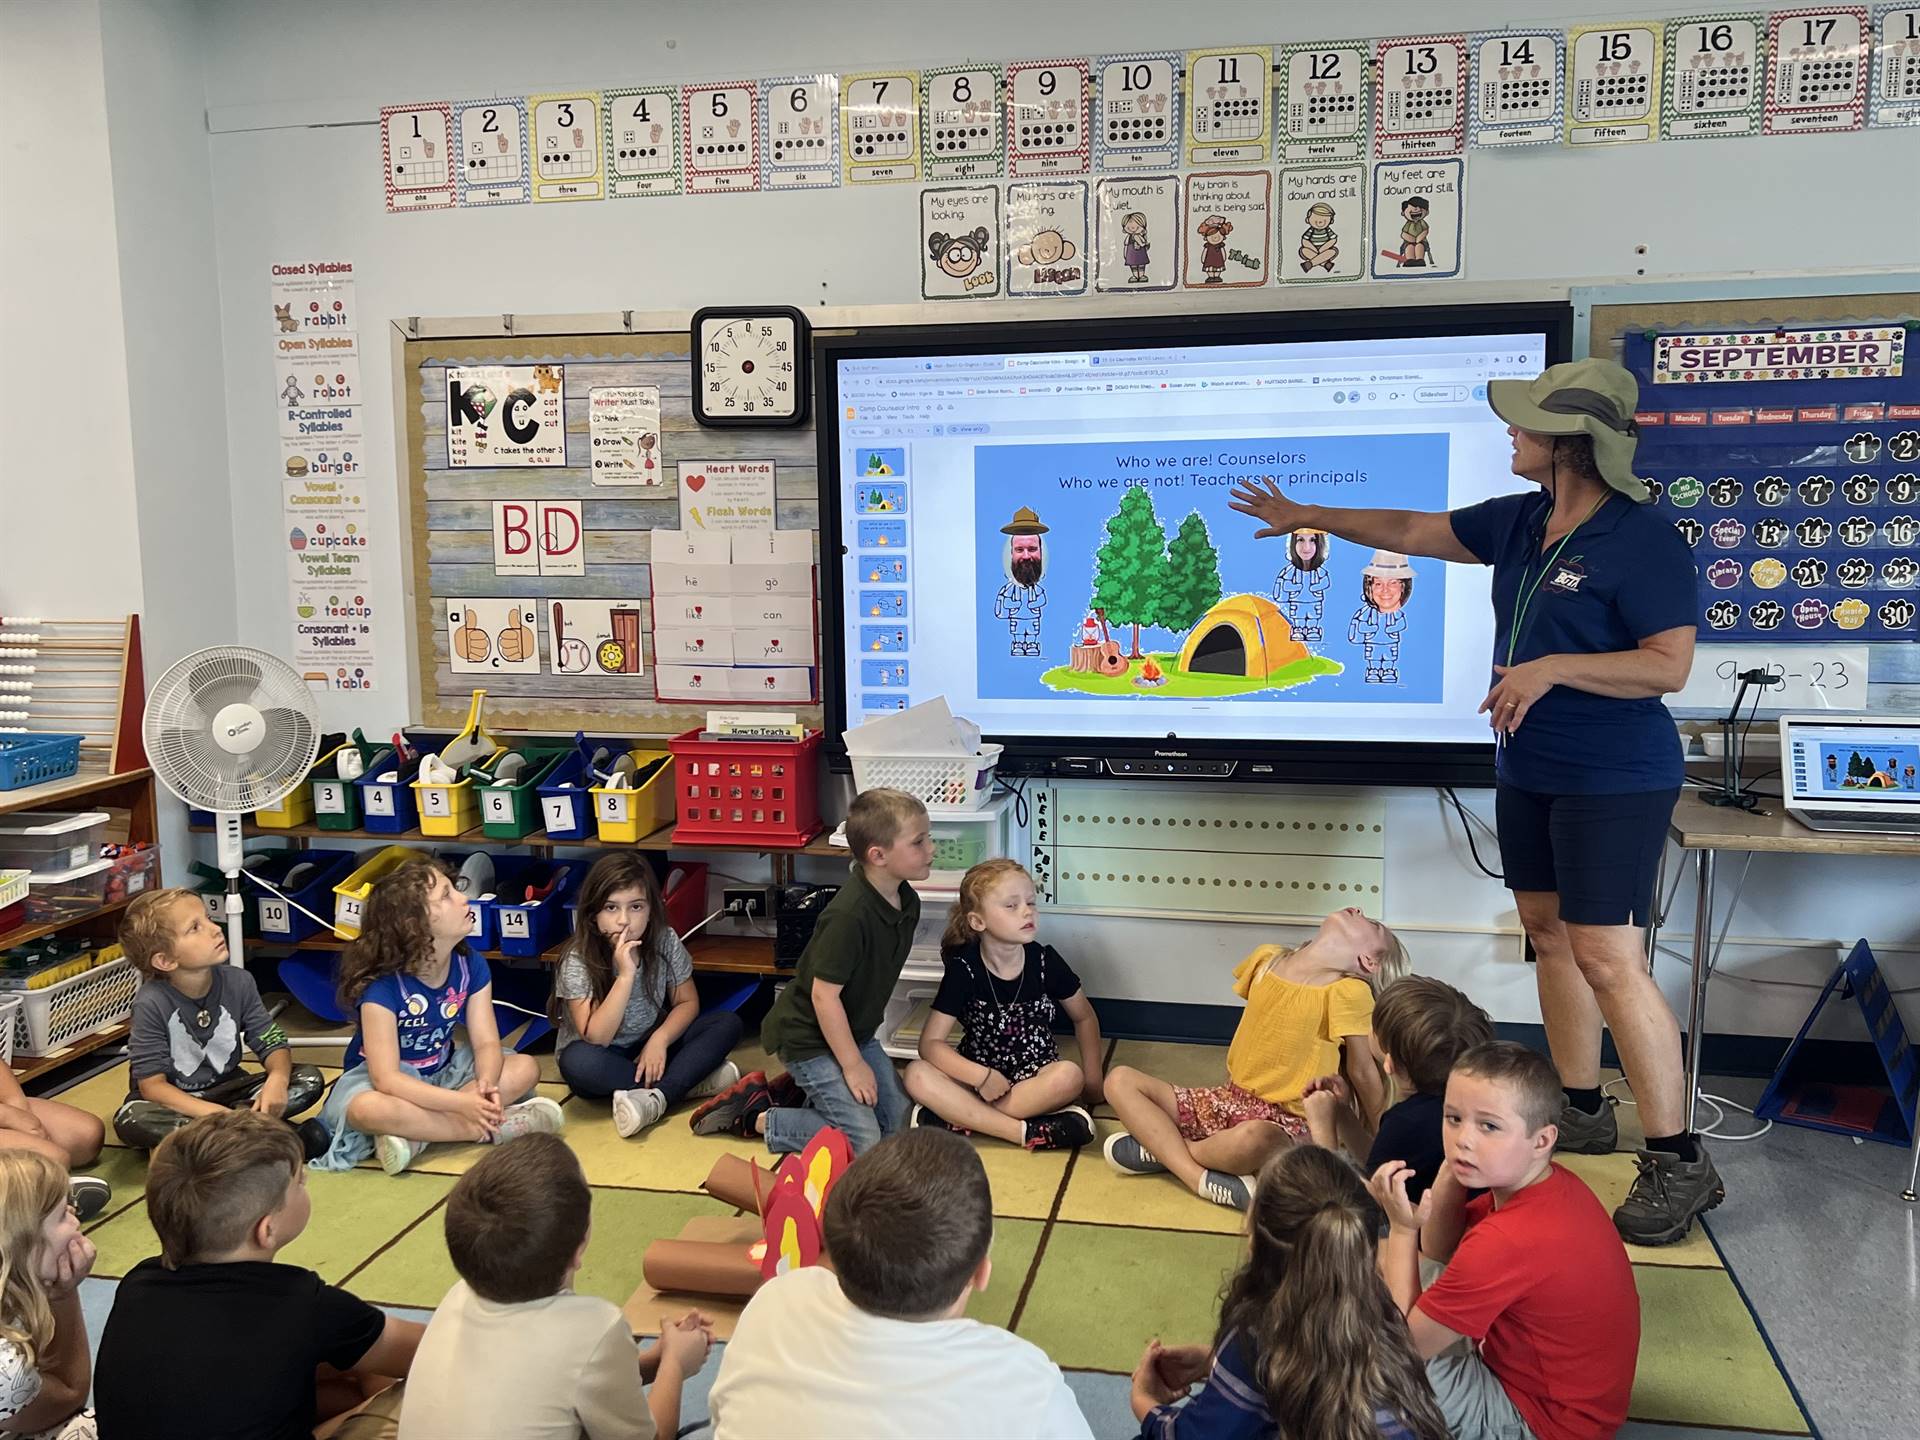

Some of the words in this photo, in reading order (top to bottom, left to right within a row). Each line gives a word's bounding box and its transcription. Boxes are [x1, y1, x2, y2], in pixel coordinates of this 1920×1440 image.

[1699, 25, 1732, 52] 16
[1803, 20, 1836, 46] 17
[1500, 40, 1535, 66] 14
[1599, 34, 1632, 61] 15
[1309, 54, 1340, 79] 12
[1406, 48, 1438, 74] 13
[1218, 59, 1240, 83] 11
[1039, 71, 1056, 95] 9
[1121, 65, 1151, 91] 10
[873, 82, 889, 103] 7
[953, 78, 971, 102] 8
[712, 94, 728, 117] 5
[790, 89, 807, 112] 6
[558, 104, 574, 126] 3
[633, 99, 650, 122] 4
[482, 110, 499, 132] 2
[1694, 120, 1727, 129] sixteen
[1791, 114, 1839, 124] seventeen
[411, 116, 421, 138] 1
[1499, 129, 1532, 138] fourteen
[1594, 128, 1626, 138] fifteen
[1308, 145, 1335, 154] twelve
[1401, 140, 1436, 149] thirteen
[1213, 148, 1239, 157] eleven
[1041, 159, 1058, 167] nine
[955, 164, 976, 174] eight
[1288, 177, 1303, 187] My
[1306, 174, 1335, 185] hands
[1339, 173, 1356, 183] are
[1385, 170, 1399, 181] My
[1403, 169, 1423, 180] feet
[1429, 169, 1445, 179] are
[1193, 181, 1205, 190] My
[1208, 180, 1229, 189] brain
[1384, 184, 1411, 195] down
[1415, 184, 1432, 193] and
[1122, 186, 1153, 196] mouth
[1193, 191, 1223, 201] thinking
[1226, 190, 1250, 199] about
[1288, 191, 1315, 200] down
[1318, 190, 1335, 199] and
[931, 198, 945, 208] My
[948, 198, 970, 207] eyes
[973, 195, 988, 204] are
[1193, 203, 1212, 212] what
[1224, 203, 1246, 213] being
[272, 264, 305, 275] Closed
[308, 262, 352, 275] Syllables
[727, 328, 732, 337] 5
[746, 323, 751, 332] 0
[762, 327, 772, 336] 55
[279, 340, 305, 352] Open
[309, 338, 352, 350] Syllables
[711, 343, 719, 352] 10
[776, 342, 786, 351] 50
[1680, 344, 1879, 369] SEPTEMBER
[706, 363, 715, 372] 15
[781, 362, 792, 372] 45
[710, 382, 719, 391] 20
[776, 382, 786, 391] 40
[594, 398, 619, 406] Writer
[725, 397, 734, 407] 25
[744, 402, 754, 411] 30
[763, 397, 773, 406] 35
[288, 408, 352, 420] R-Controlled
[503, 387, 539, 444] C
[1675, 416, 1701, 424] Monday
[1718, 415, 1744, 423] Tuesday
[1756, 412, 1793, 422] Wednesday
[1802, 411, 1832, 420] Thursday
[1853, 409, 1874, 419] Friday
[299, 423, 343, 434] Syllables
[1858, 441, 1867, 459] 1
[1901, 439, 1912, 458] 2
[1116, 456, 1150, 469] Who
[1156, 456, 1177, 467] we
[1182, 454, 1213, 467] are!
[1218, 452, 1306, 466] Counselors
[706, 465, 735, 473] Heart
[739, 465, 769, 473] Words
[1059, 477, 1092, 489] Who
[1098, 477, 1118, 488] we
[1124, 476, 1149, 488] are
[1154, 474, 1184, 487] not!
[1190, 473, 1260, 486] Teachers
[1268, 472, 1283, 484] or
[1289, 470, 1367, 486] principals
[1675, 490, 1701, 501] SCHOOL
[1719, 486, 1730, 503] 5
[1765, 485, 1777, 502] 6
[1811, 484, 1823, 501] 7
[1855, 483, 1866, 500] 8
[1898, 482, 1909, 499] 9
[707, 507, 734, 516] Flash
[738, 507, 771, 516] Words
[1761, 526, 1780, 544] 13
[1804, 526, 1822, 544] 14
[1847, 525, 1866, 543] 15
[1892, 524, 1911, 542] 16
[310, 535, 366, 548] cupcake
[298, 553, 329, 562] Vowel
[332, 553, 359, 562] Team
[308, 566, 351, 577] Syllables
[1712, 566, 1737, 577] Library
[1800, 565, 1820, 585] 21
[1843, 566, 1866, 585] 22
[1888, 565, 1911, 584] 23
[325, 606, 371, 617] teacup
[1800, 606, 1818, 614] Open
[450, 612, 459, 622] a
[525, 613, 534, 622] e
[1712, 608, 1734, 626] 26
[1756, 608, 1779, 626] 27
[1885, 606, 1907, 625] 30
[1800, 613, 1821, 621] House
[298, 624, 348, 633] Consonant
[313, 637, 356, 647] Syllables
[324, 789, 332, 800] 3
[374, 791, 382, 803] 4
[431, 793, 439, 804] 5
[493, 799, 502, 811] 6
[608, 798, 617, 811] 8
[553, 806, 561, 818] 7
[1037, 793, 1047, 841] HERE
[210, 900, 217, 911] 9
[346, 903, 360, 914] 11
[266, 908, 282, 919] 10
[505, 913, 523, 925] 14
